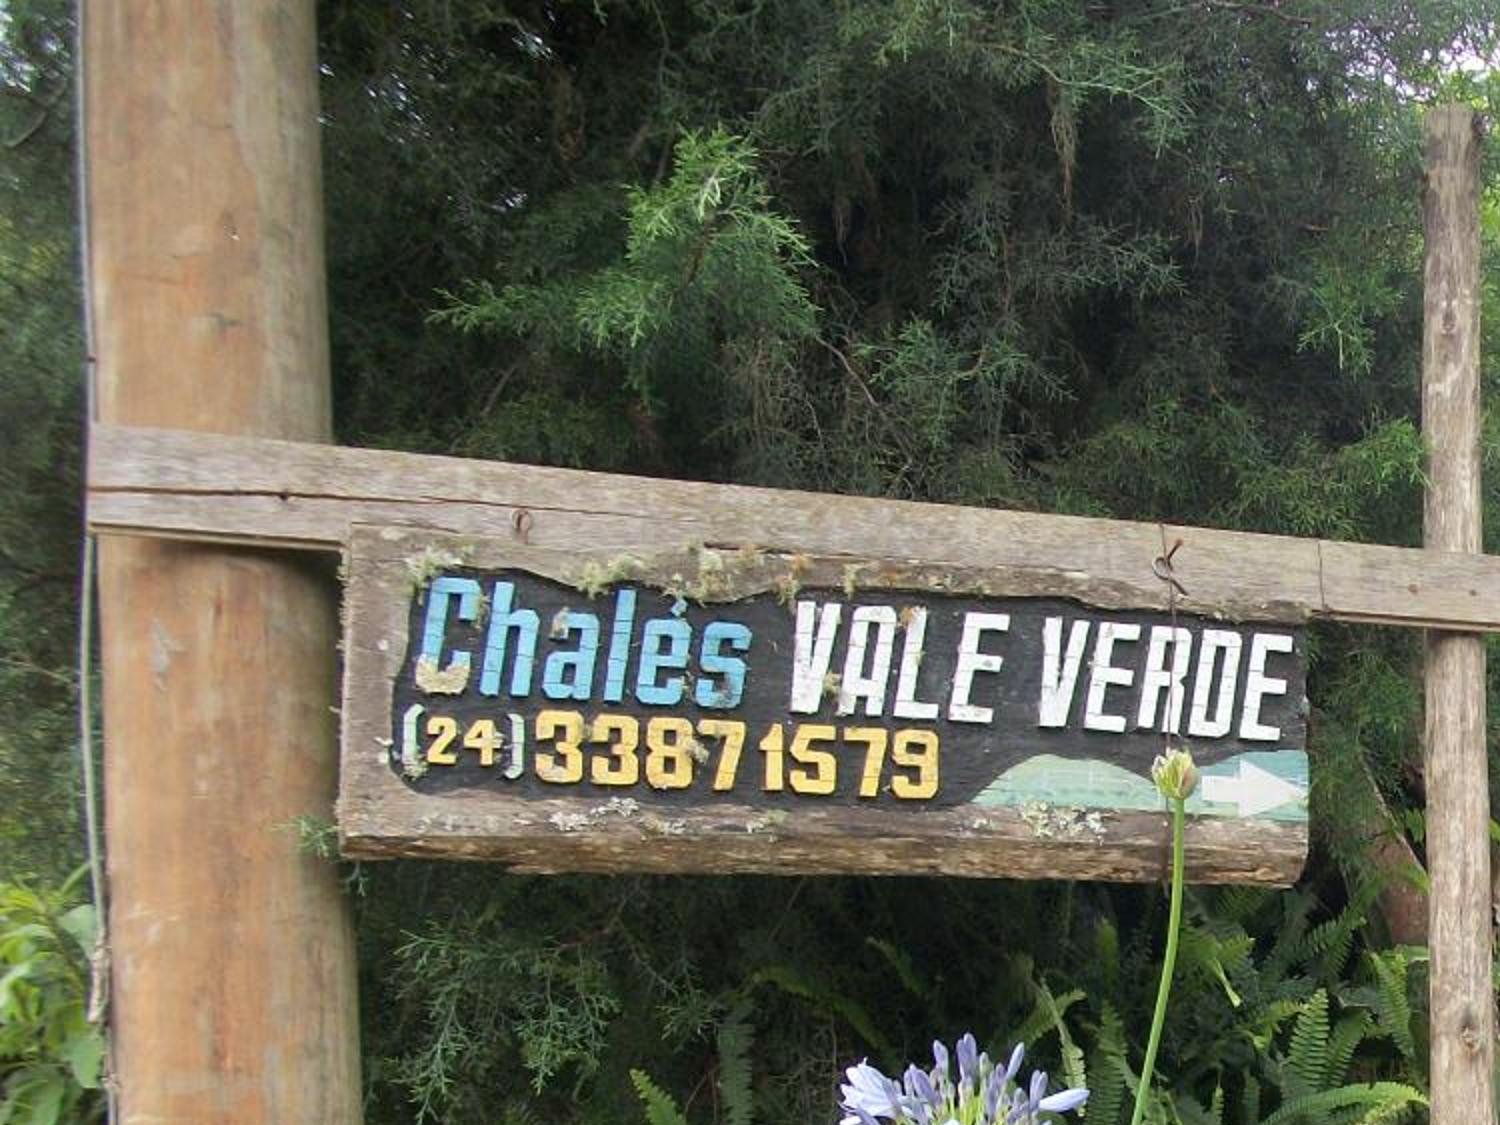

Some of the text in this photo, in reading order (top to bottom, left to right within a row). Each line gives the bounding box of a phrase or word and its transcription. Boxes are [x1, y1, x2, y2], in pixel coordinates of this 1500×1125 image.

[414, 576, 1294, 741] Chalés VALE VERDE
